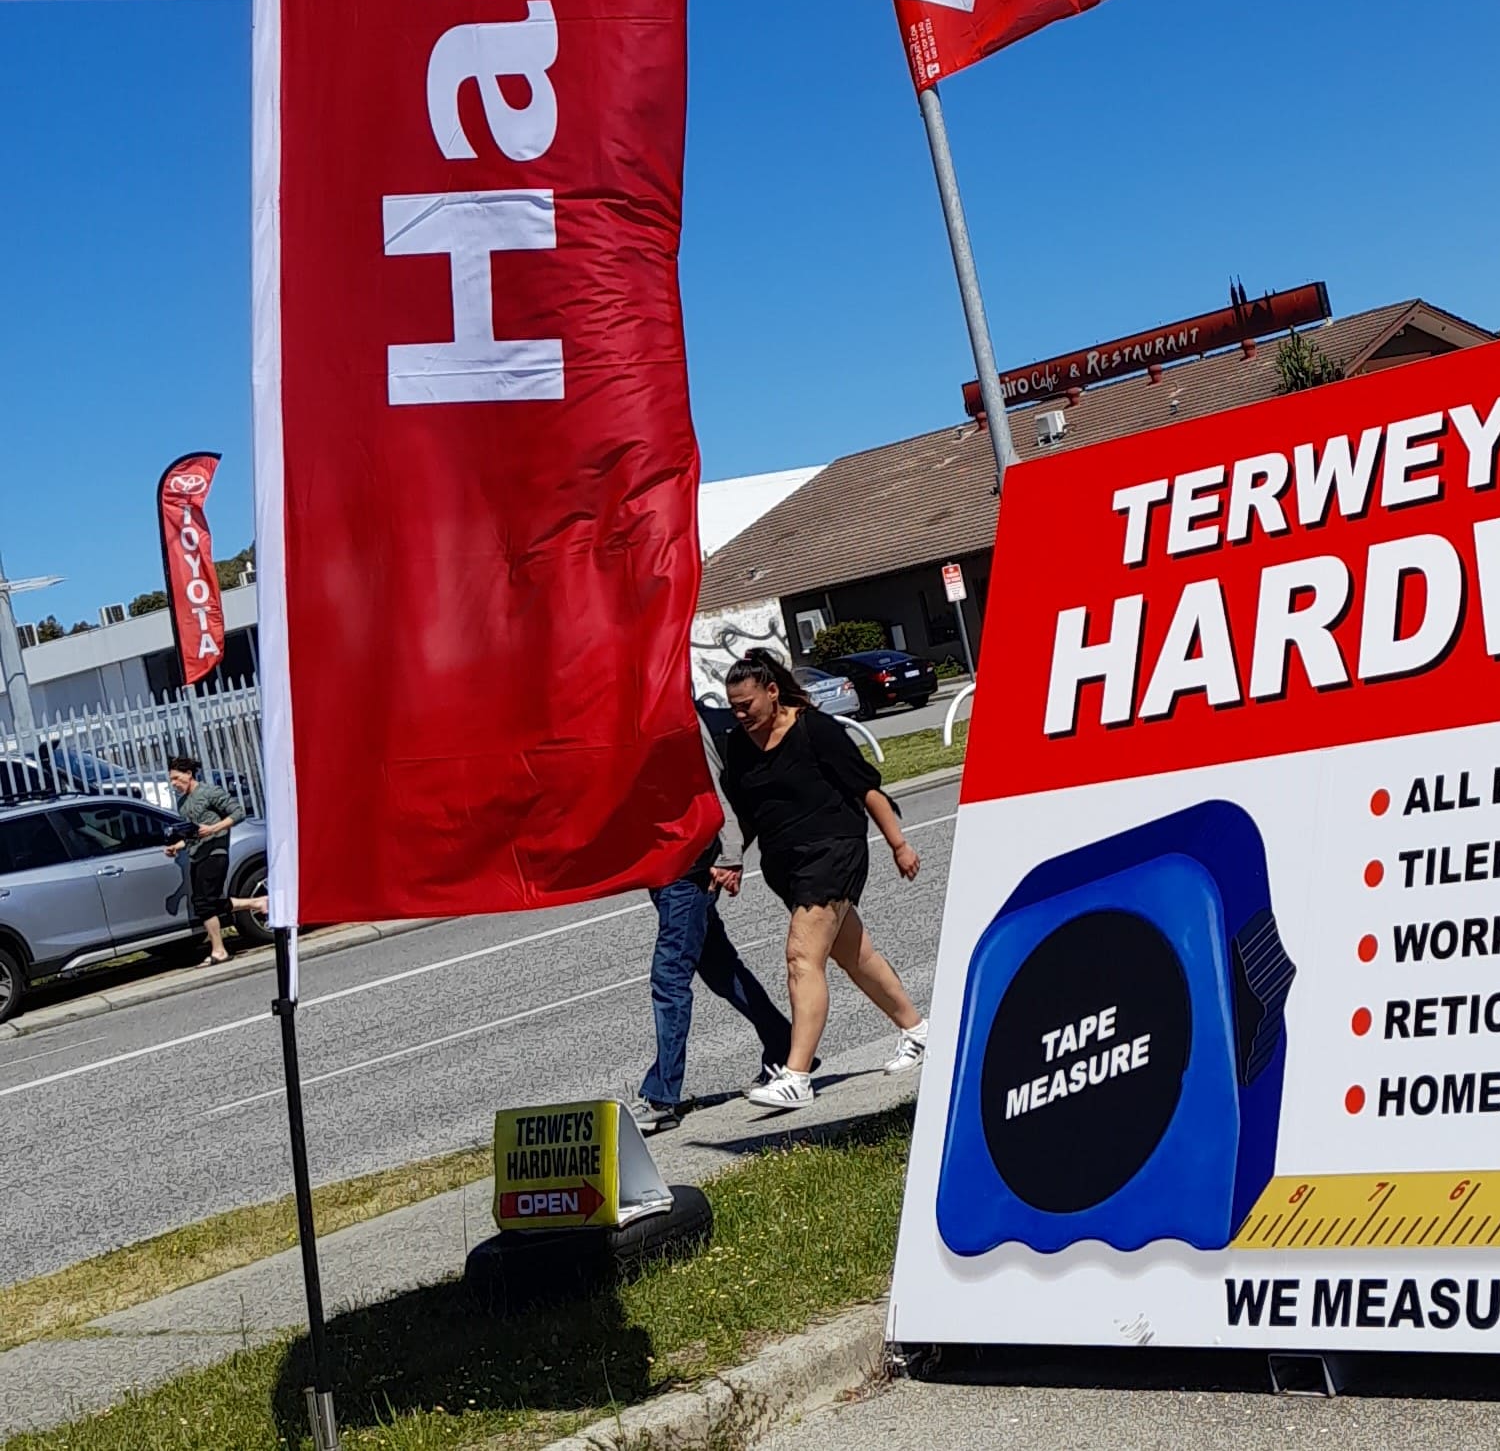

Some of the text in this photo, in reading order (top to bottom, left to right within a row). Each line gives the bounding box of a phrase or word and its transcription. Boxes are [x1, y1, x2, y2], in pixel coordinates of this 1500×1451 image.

[999, 376, 1029, 399] airo
[1070, 362, 1081, 378] &
[1086, 327, 1200, 377] RESTAURANT
[180, 503, 221, 659] TOYOTA
[1403, 771, 1481, 816] ALL
[1041, 1006, 1118, 1063] TAPE
[1004, 1033, 1151, 1120] MEASURE
[516, 1110, 594, 1147] TERWEYS
[507, 1144, 601, 1181] HARDWARE
[517, 1191, 580, 1215] OPEN
[1288, 1184, 1309, 1205] 8
[1367, 1182, 1387, 1202] 7
[1449, 1180, 1471, 1201] 6
[1225, 1278, 1300, 1327] WE
